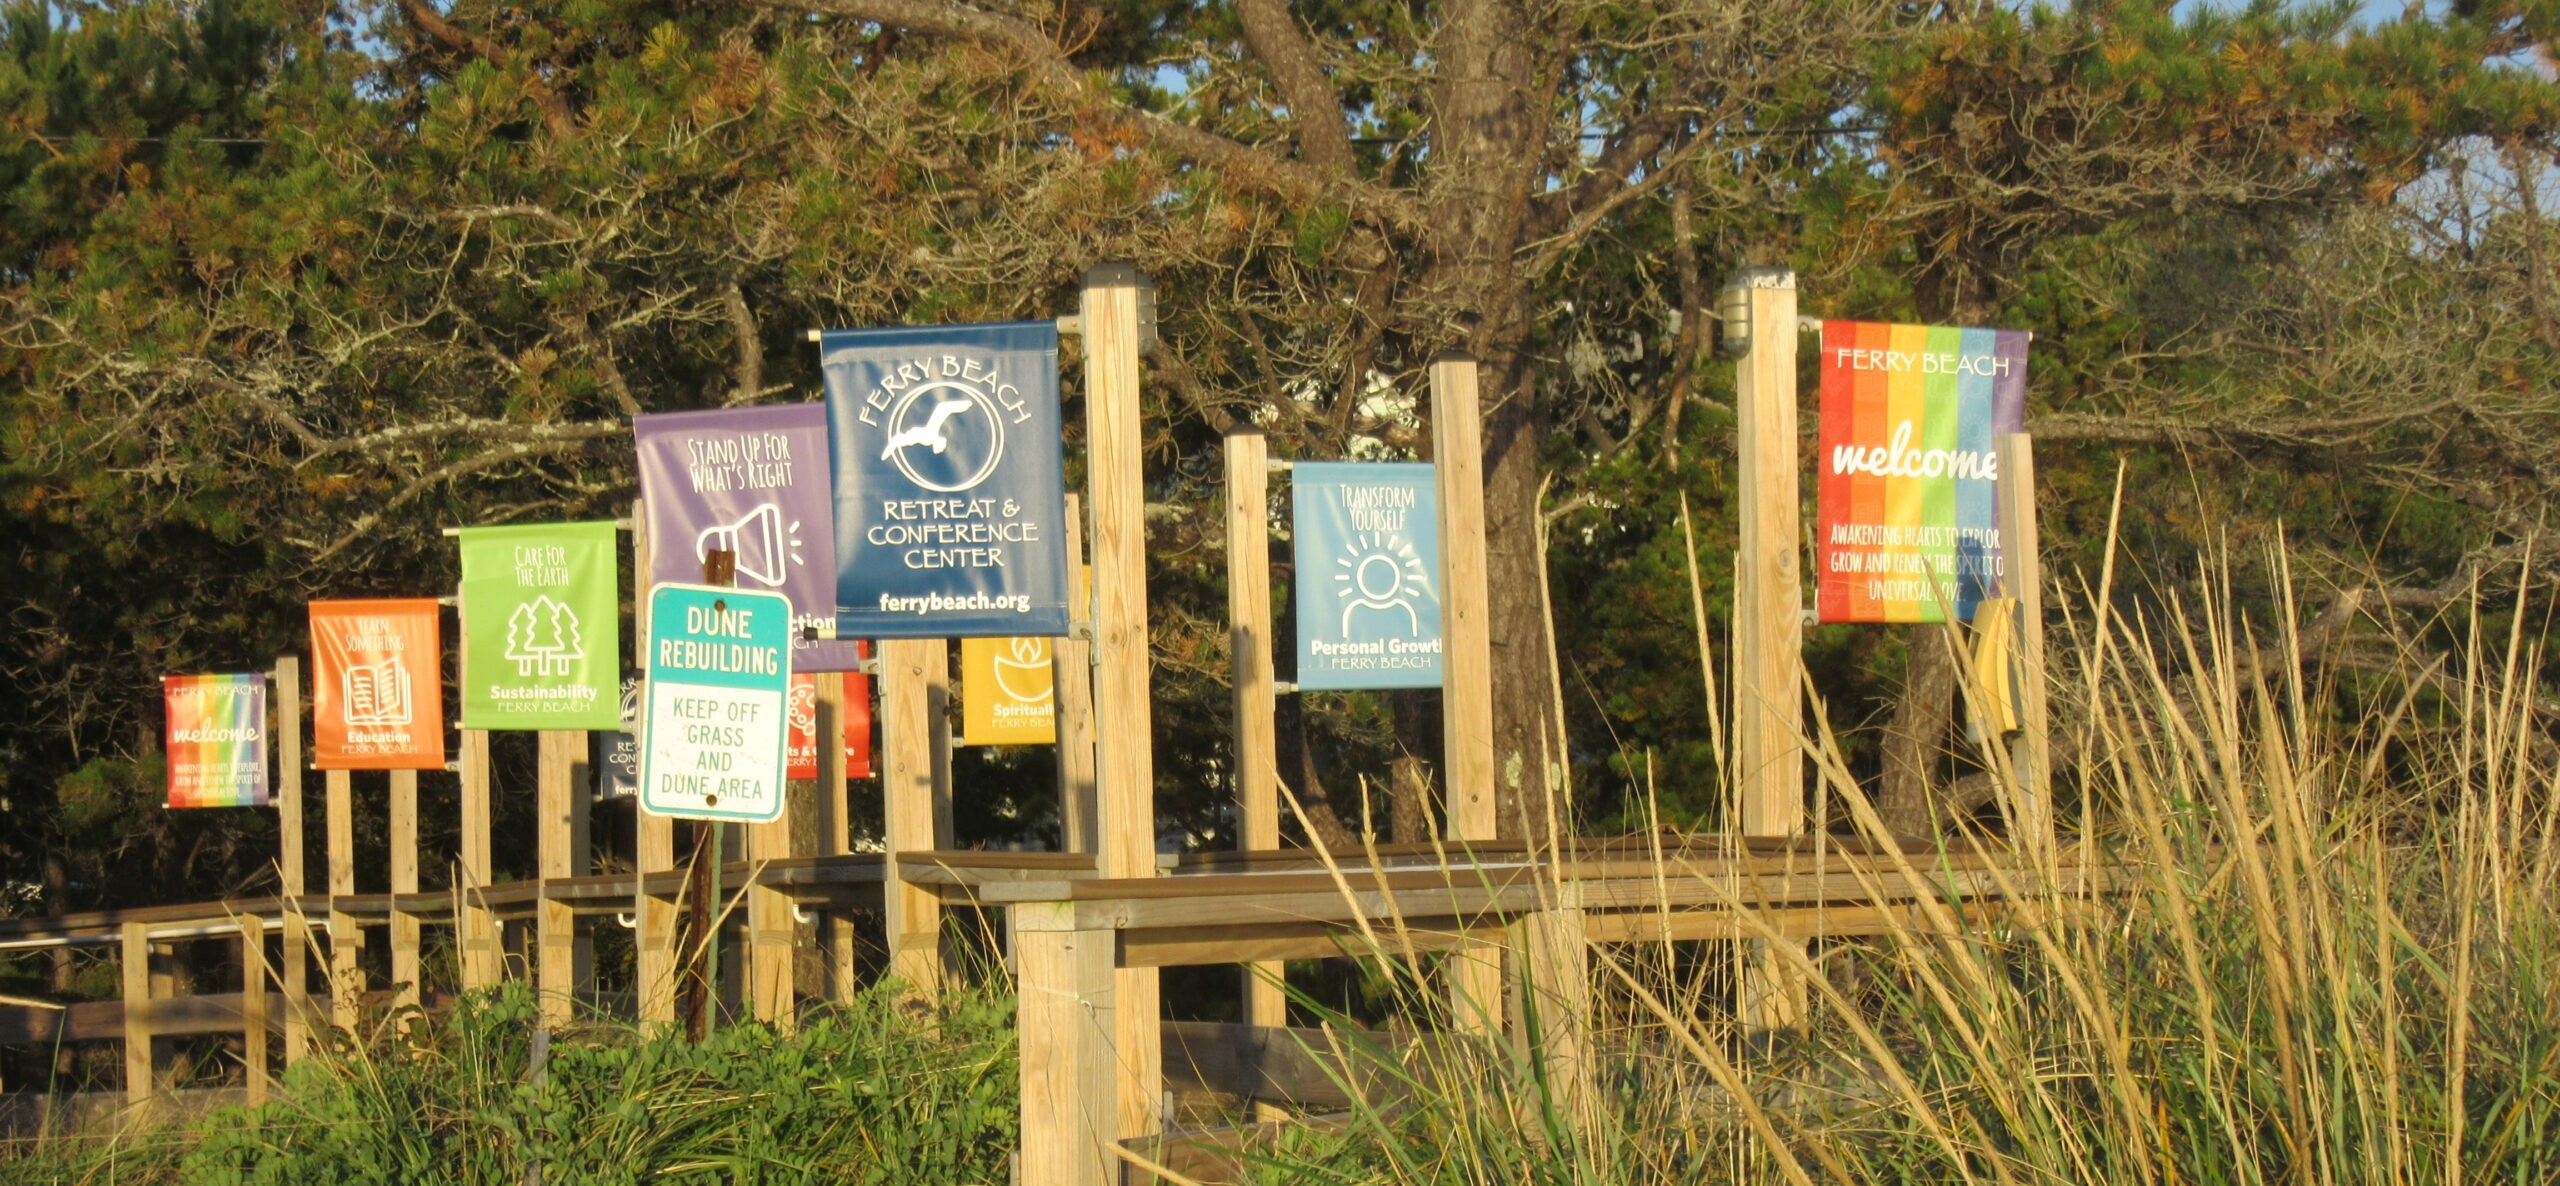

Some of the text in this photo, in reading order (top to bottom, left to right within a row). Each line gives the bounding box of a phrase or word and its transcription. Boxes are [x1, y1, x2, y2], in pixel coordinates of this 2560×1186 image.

[1837, 348, 2009, 378] FERRY BEACH
[858, 355, 1032, 427] FERRY BEACH
[687, 433, 791, 466] STAND UP FOR
[1832, 420, 1998, 481] welcome
[689, 462, 793, 494] WHAT'S RIGHT
[1340, 484, 1415, 510] TRANSFORM
[884, 498, 1021, 520] RETREAT &
[1349, 508, 1405, 531] YOURSELF
[867, 523, 1039, 546] CONFERENCE
[1830, 523, 2001, 549] AWAKENING HEARTS TO EXPLOR
[515, 544, 566, 568] CARE FOR
[904, 548, 1005, 569] CENTER
[1830, 552, 1863, 573] GROW
[1865, 552, 1890, 572] AND
[1934, 554, 1954, 575] THE
[1956, 555, 1993, 576] SPIRIT
[1995, 555, 2004, 577] O
[515, 566, 569, 587] THE EARTH
[1868, 580, 1935, 601] UNIVERSAL
[879, 591, 1030, 615] ferrybeach.org
[359, 618, 389, 634] LEARN
[687, 606, 753, 639] DUNE
[345, 635, 404, 652] SOMETHING
[1311, 638, 1384, 656] Personal
[660, 638, 778, 676] REBUILDING
[1331, 657, 1431, 670] FERRY BEACH
[490, 684, 598, 702] Sustainability
[498, 702, 591, 713] FERRY BEACH
[673, 697, 761, 723] KEEP OFF
[993, 703, 1055, 719] Spirituali
[173, 717, 259, 743] welcome
[992, 718, 1026, 729] FERRY
[347, 731, 411, 743] Education
[687, 724, 744, 747] GRASS
[342, 744, 418, 754] FERRY BEACH
[696, 751, 732, 772] AND
[662, 773, 710, 796] DUNE
[717, 777, 763, 800] AREA
